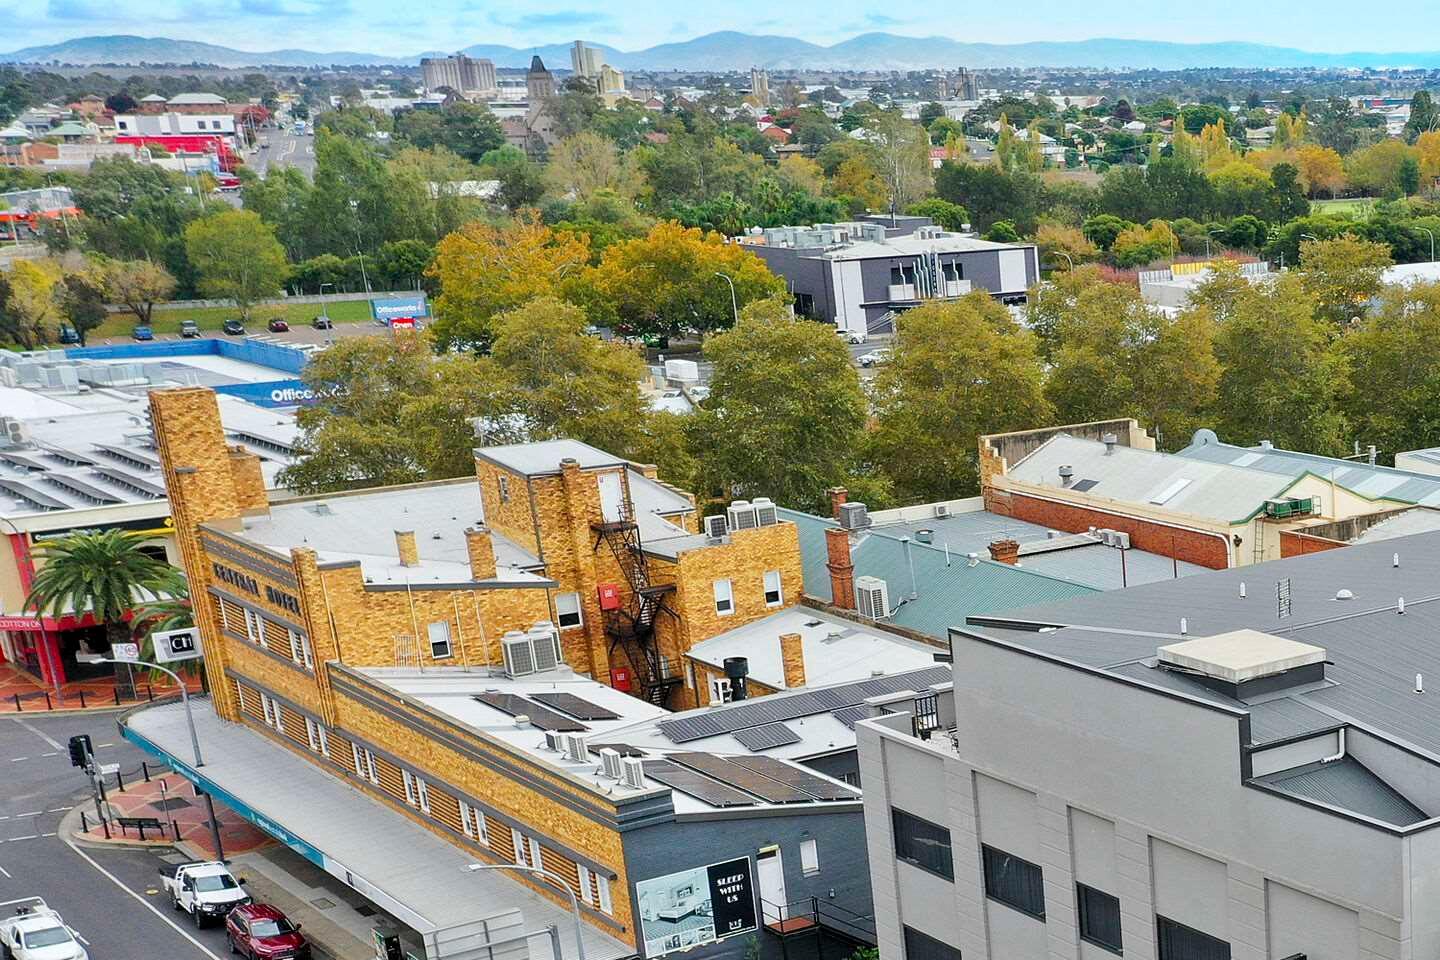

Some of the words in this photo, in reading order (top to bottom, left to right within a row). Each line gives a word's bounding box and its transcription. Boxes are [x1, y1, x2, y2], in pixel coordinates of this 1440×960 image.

[213, 562, 260, 599] CENTRAL
[717, 873, 744, 886] SLEEP
[720, 884, 743, 895] WITH
